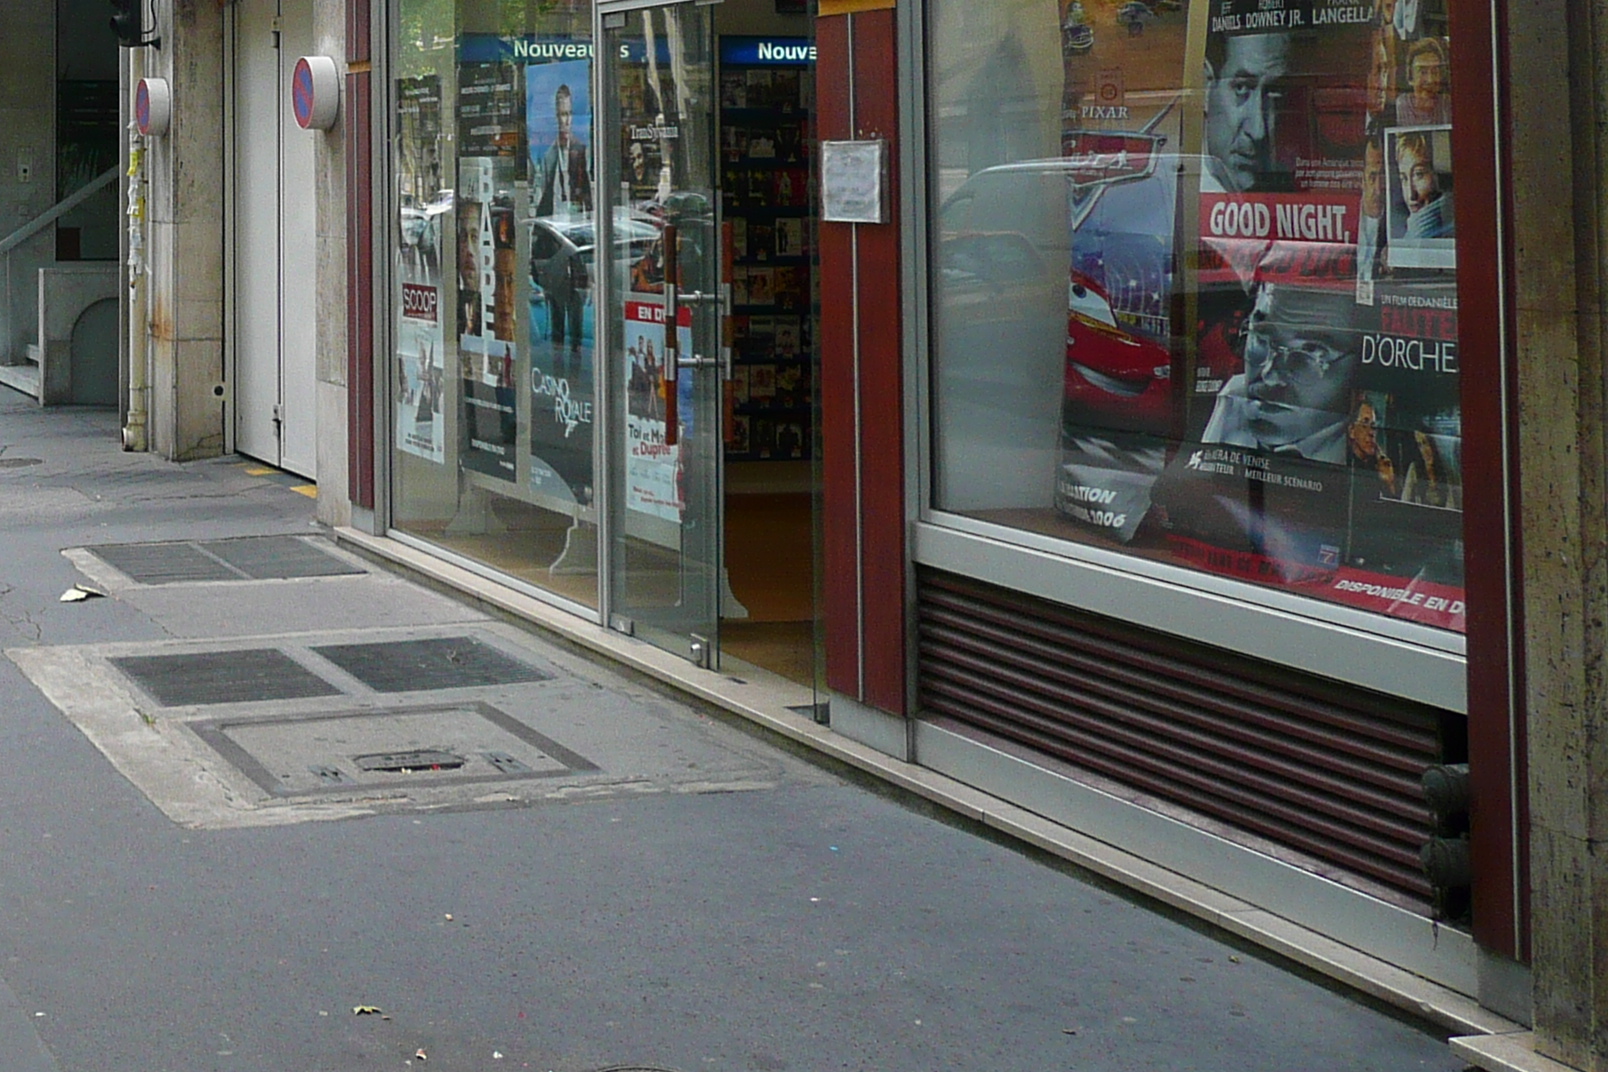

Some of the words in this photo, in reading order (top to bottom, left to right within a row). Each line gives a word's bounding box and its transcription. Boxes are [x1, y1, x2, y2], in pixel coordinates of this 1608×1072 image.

[1212, 15, 1242, 33] DANIELS
[1245, 9, 1286, 29] DOWNEY
[1081, 105, 1130, 120] PIXAR
[1209, 200, 1271, 238] GOOD
[403, 288, 437, 314] SCOOP
[1362, 334, 1458, 373] D'ORCHE
[1244, 467, 1283, 485] MEILLEUR
[1334, 579, 1425, 606] DISPONIBLE
[1424, 596, 1450, 612] EN
